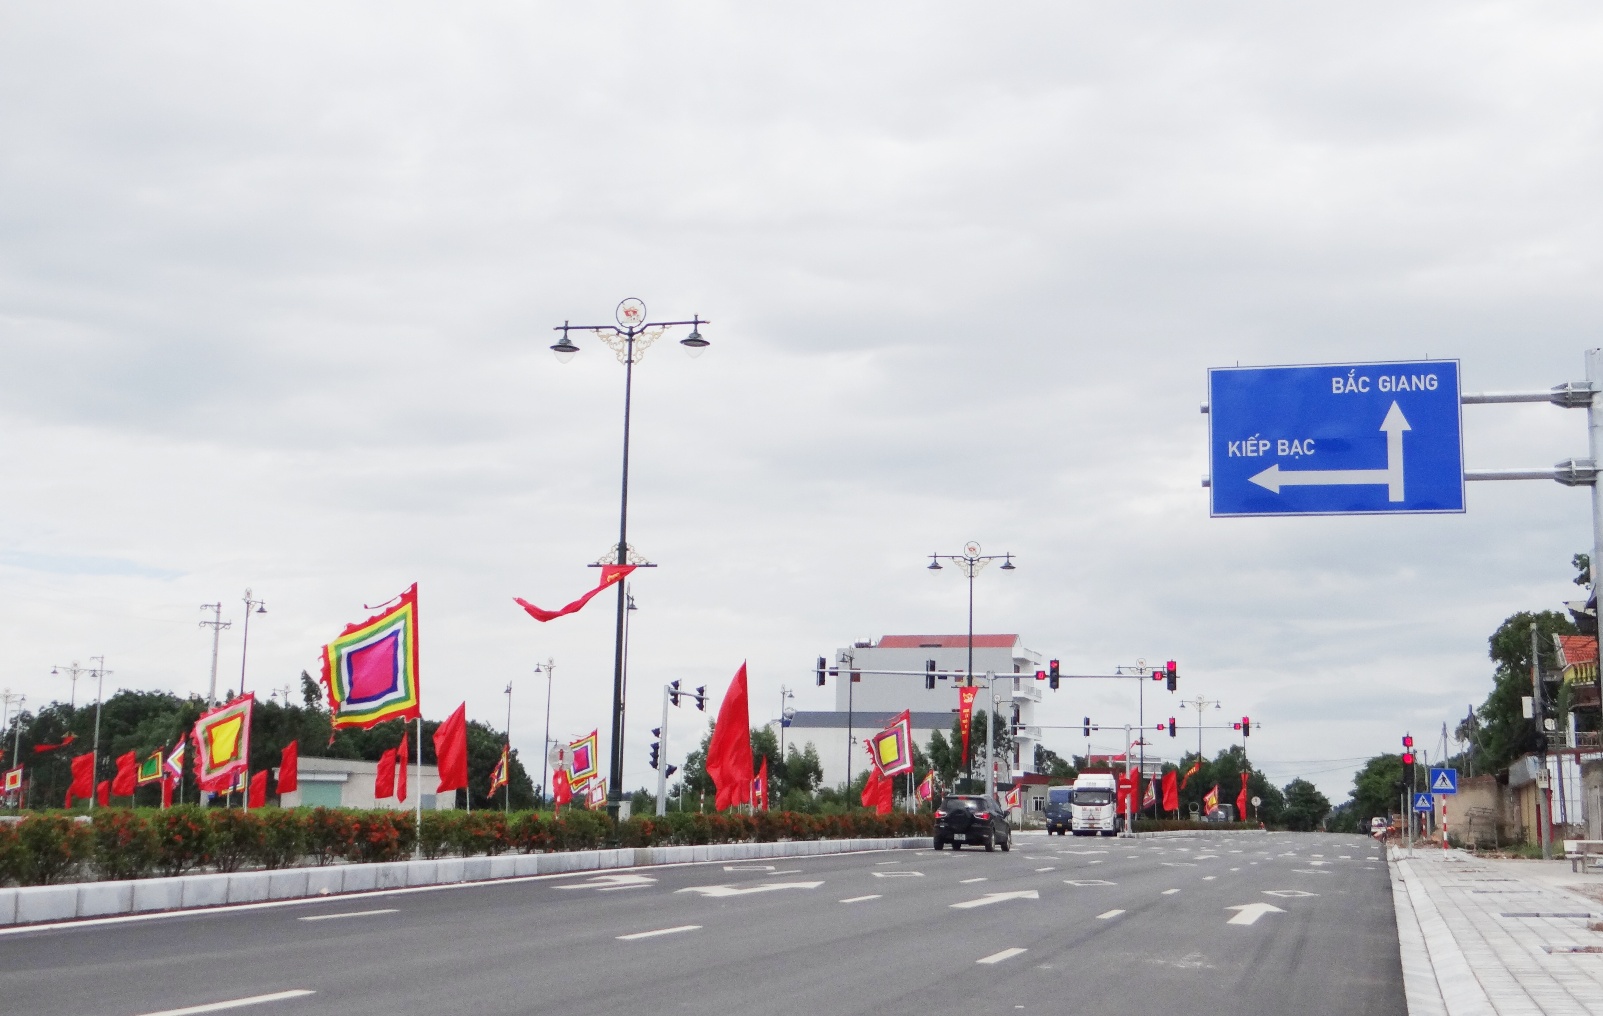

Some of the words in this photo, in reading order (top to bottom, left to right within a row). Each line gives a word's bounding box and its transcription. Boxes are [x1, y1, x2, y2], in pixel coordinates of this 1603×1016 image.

[1332, 369, 1370, 393] BẮC
[1378, 373, 1439, 392] GIANG
[1228, 433, 1271, 457] KIẾP
[1277, 438, 1315, 459] BẠC
